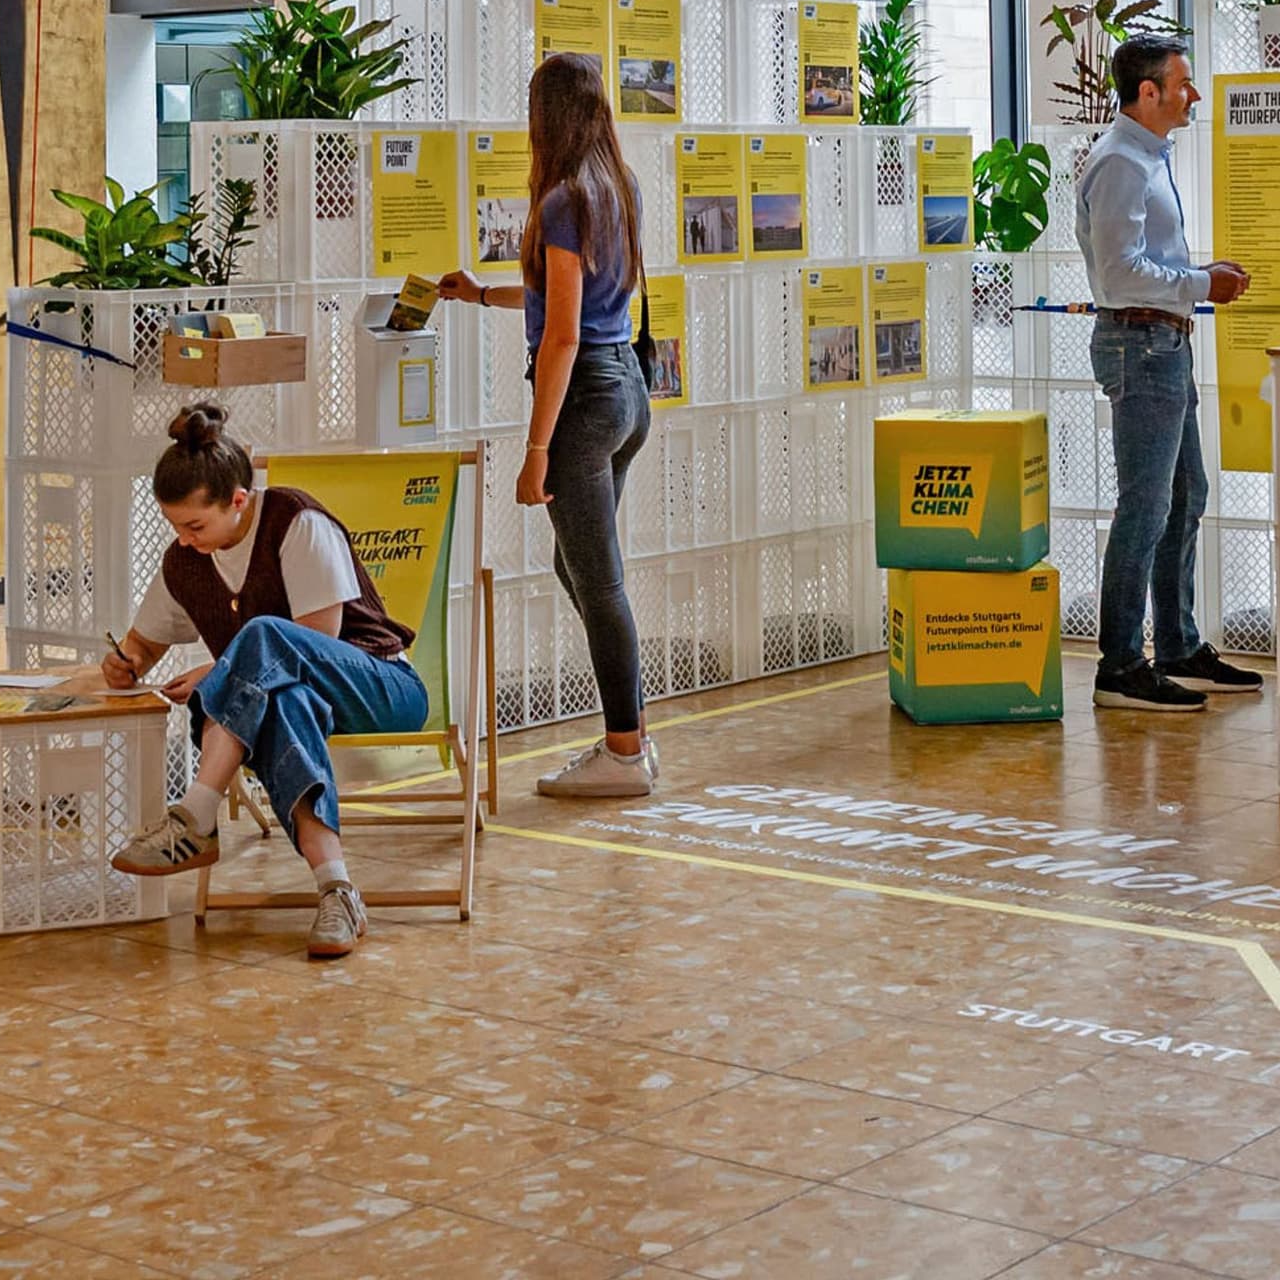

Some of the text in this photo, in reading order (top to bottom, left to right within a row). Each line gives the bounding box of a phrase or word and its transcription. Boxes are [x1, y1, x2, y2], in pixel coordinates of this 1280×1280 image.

[1229, 91, 1261, 108] WHAT
[385, 139, 414, 154] FUTURE
[385, 154, 408, 168] POINT
[406, 475, 441, 487] JETZT
[913, 464, 972, 481] JETZT
[912, 482, 975, 499] KLIMA
[910, 499, 970, 517] CHEN!
[926, 612, 1022, 625] Entdecke Stuttgarts
[926, 624, 988, 637] Futurepoints
[704, 784, 1180, 854] GEMEINSAM
[621, 802, 1017, 861] ZUKUNFT
[956, 1003, 1252, 1062] STUTTGART
